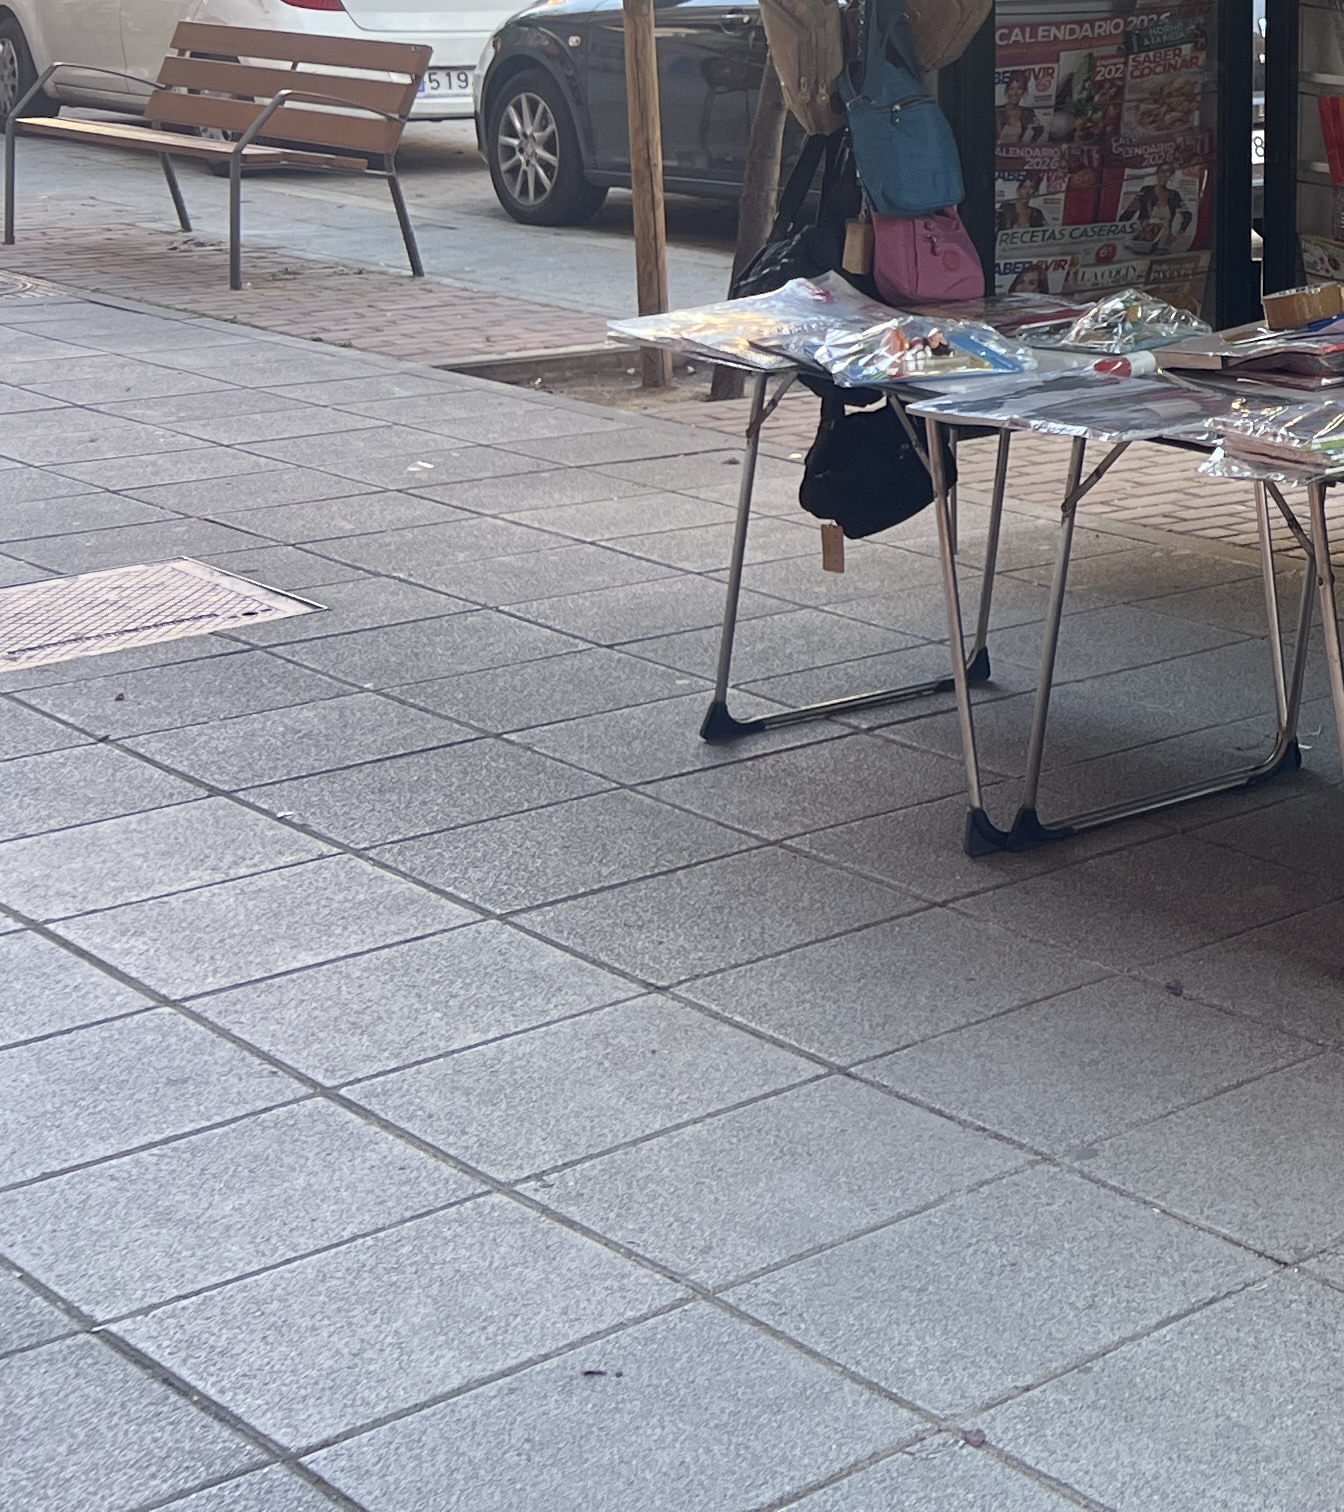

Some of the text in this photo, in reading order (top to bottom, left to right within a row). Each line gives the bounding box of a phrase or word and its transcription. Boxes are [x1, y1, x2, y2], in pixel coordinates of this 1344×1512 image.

[995, 18, 1126, 46] CALENDARIO
[1129, 55, 1200, 80] COCINAR
[1130, 46, 1182, 67] SABER
[1023, 158, 1060, 170] 2026
[998, 221, 1138, 247] RECETAS CASERAS
